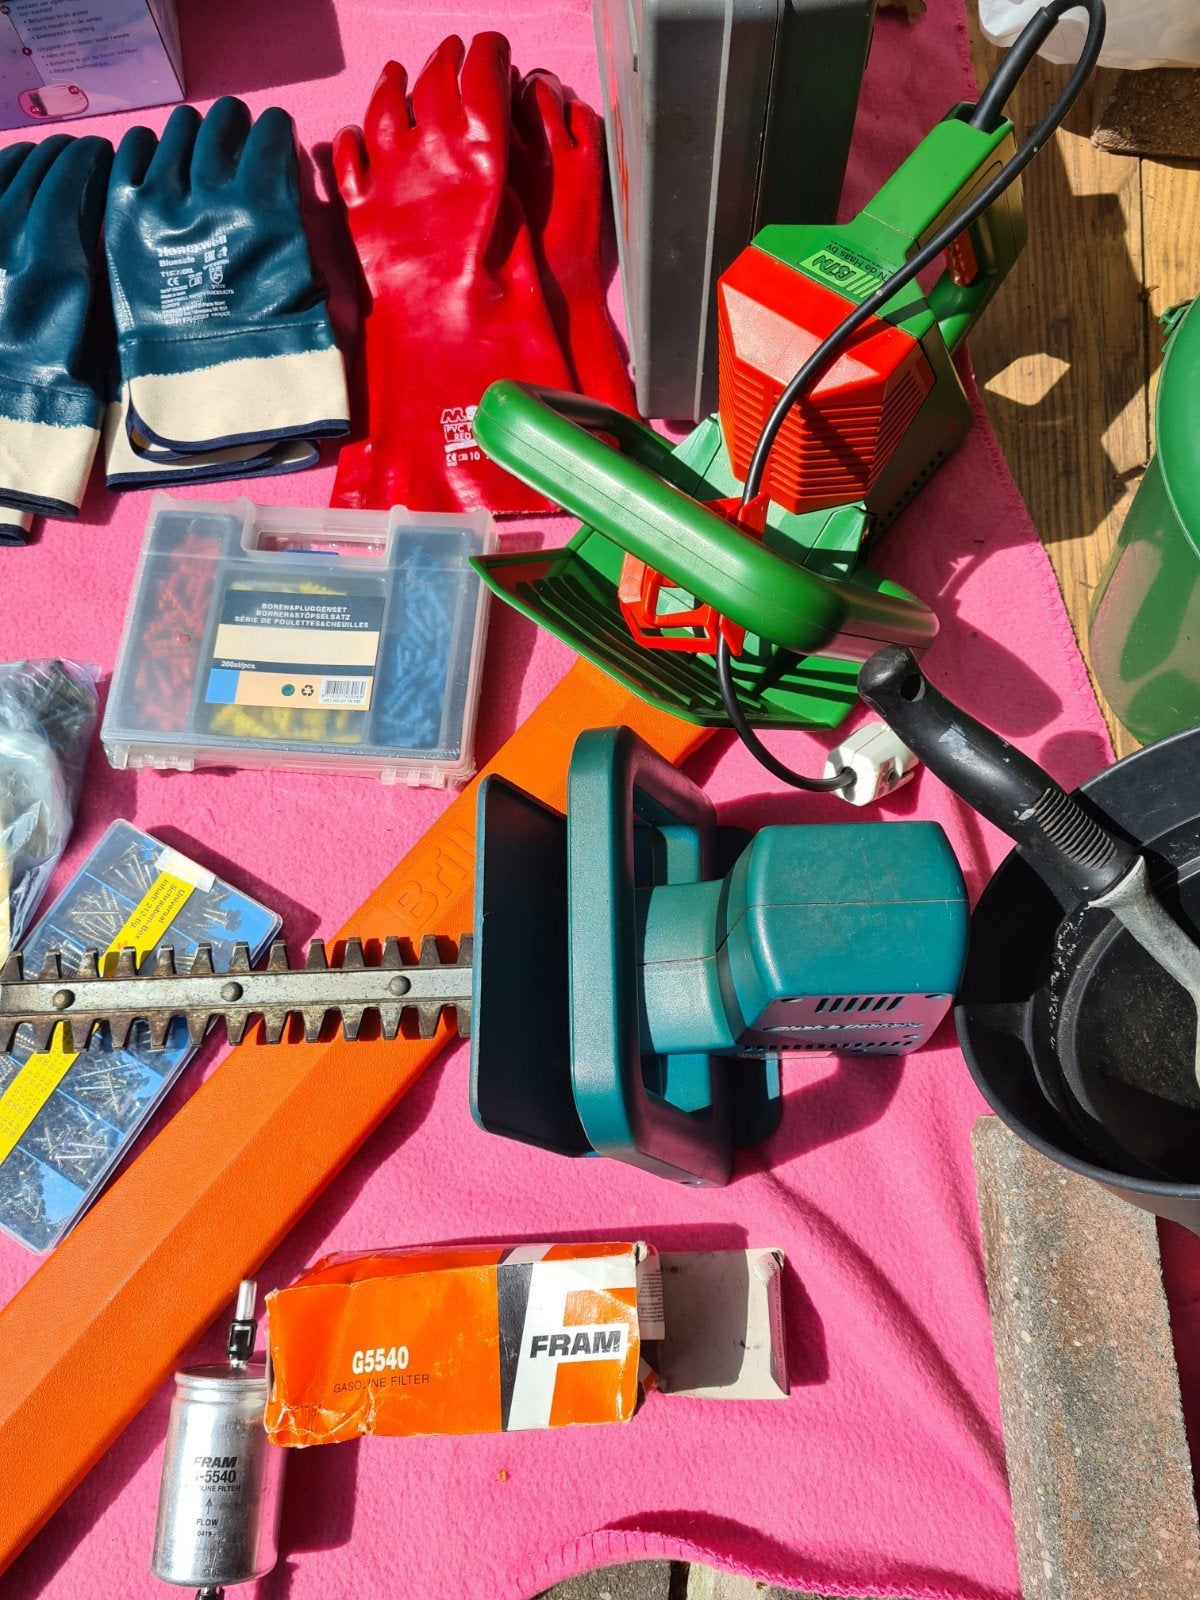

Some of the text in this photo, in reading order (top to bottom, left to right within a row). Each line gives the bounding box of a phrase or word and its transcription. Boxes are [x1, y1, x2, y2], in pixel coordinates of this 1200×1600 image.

[156, 235, 227, 257] Honeywell
[826, 244, 838, 255] bv
[159, 257, 195, 267] Bluesafe
[812, 255, 856, 281] BTN
[840, 250, 864, 268] Haas
[864, 264, 878, 274] de
[256, 609, 351, 620] BOHRER&STÖPSELSATZ
[261, 603, 347, 613] BOREN&PLUGGENSET
[135, 884, 177, 940] Schrauben-Box
[159, 889, 185, 924] Universal
[530, 1331, 621, 1358] FRAM
[352, 1346, 409, 1374] G5540
[334, 1374, 430, 1393] GASOLINE FILTER
[194, 1456, 238, 1468] FRAM
[196, 1470, 236, 1483] -5540
